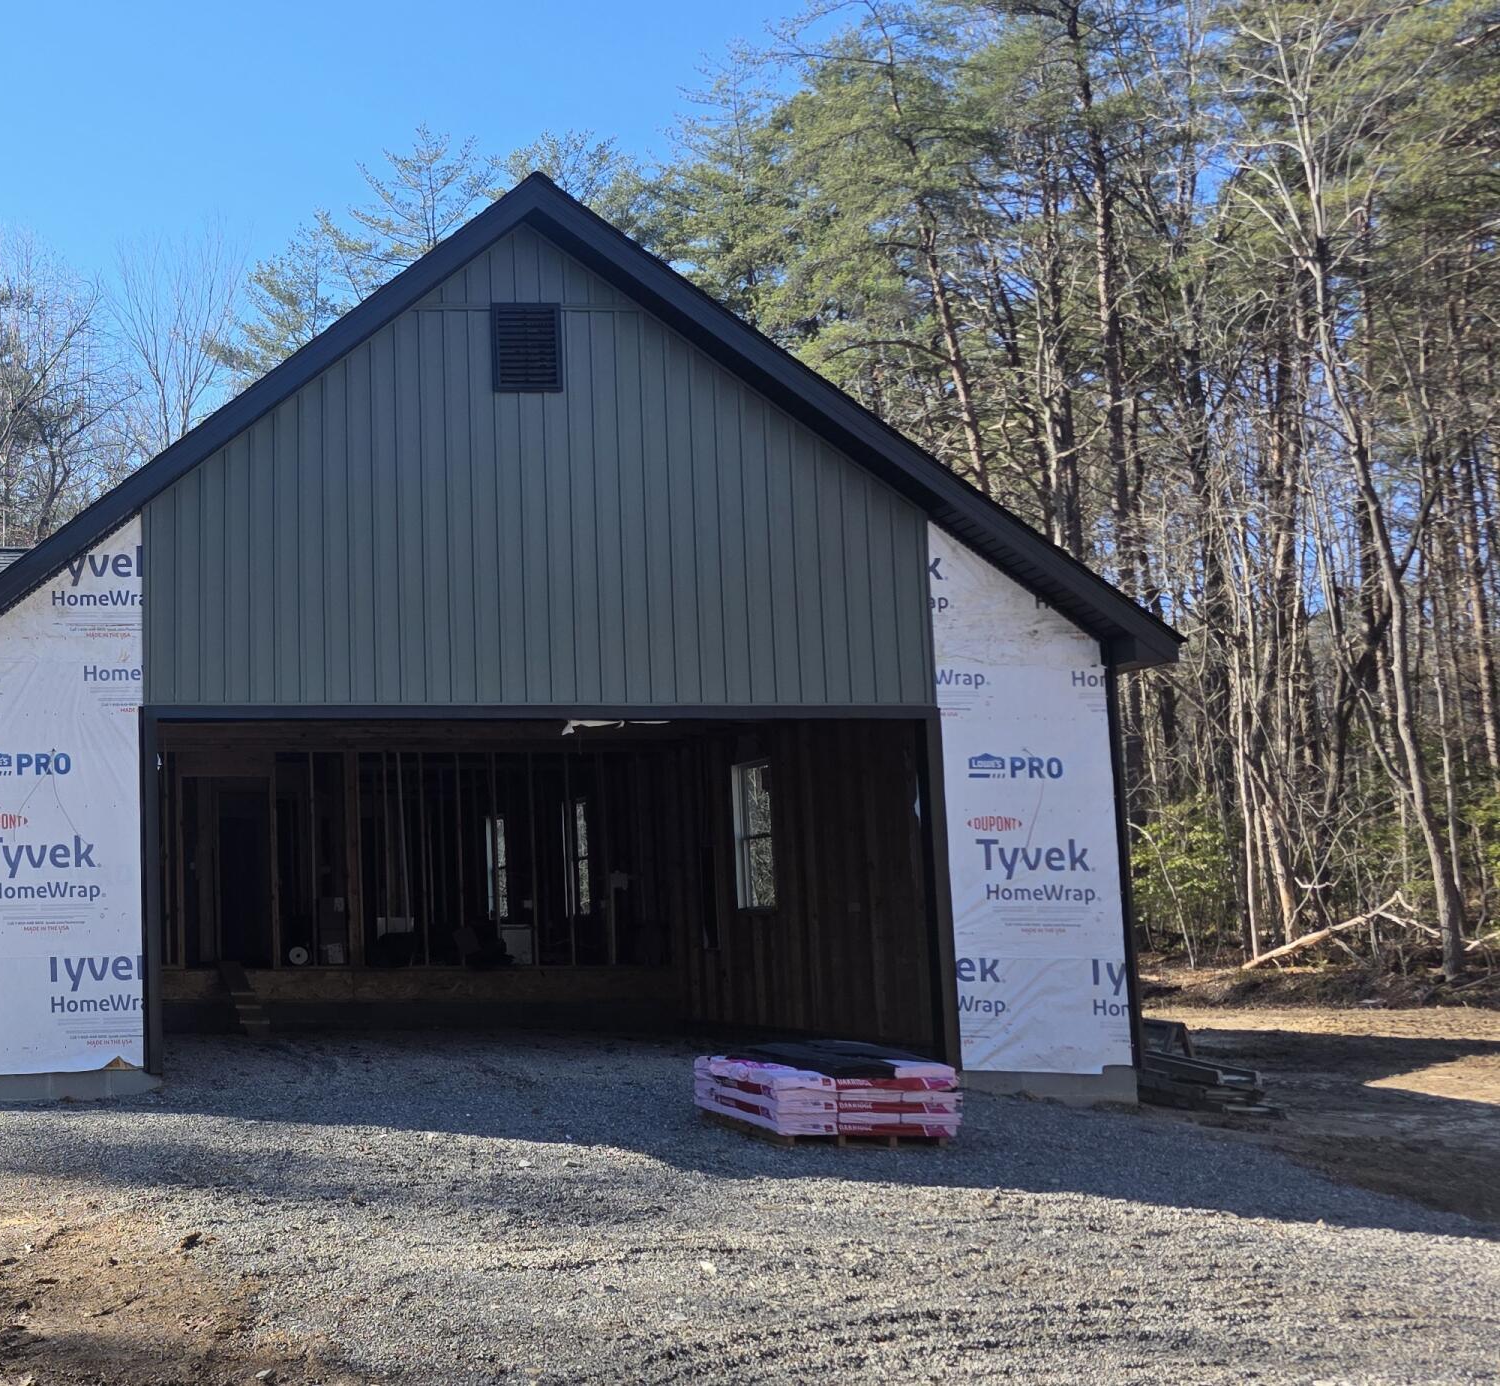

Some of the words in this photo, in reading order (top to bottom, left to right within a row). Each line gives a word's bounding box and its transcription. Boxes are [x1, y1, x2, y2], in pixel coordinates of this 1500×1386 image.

[67, 545, 143, 586] yve
[52, 590, 143, 607] HomeWr
[83, 665, 142, 682] Home
[936, 669, 985, 689] Wrap
[16, 752, 71, 776] PRO
[1010, 756, 1063, 779] PRO
[973, 815, 1017, 832] DUPONT
[975, 838, 1091, 880] Tyvek
[985, 883, 1096, 905] HomeWrap
[51, 994, 143, 1014] HomeWr
[957, 995, 1006, 1017] Wrap
